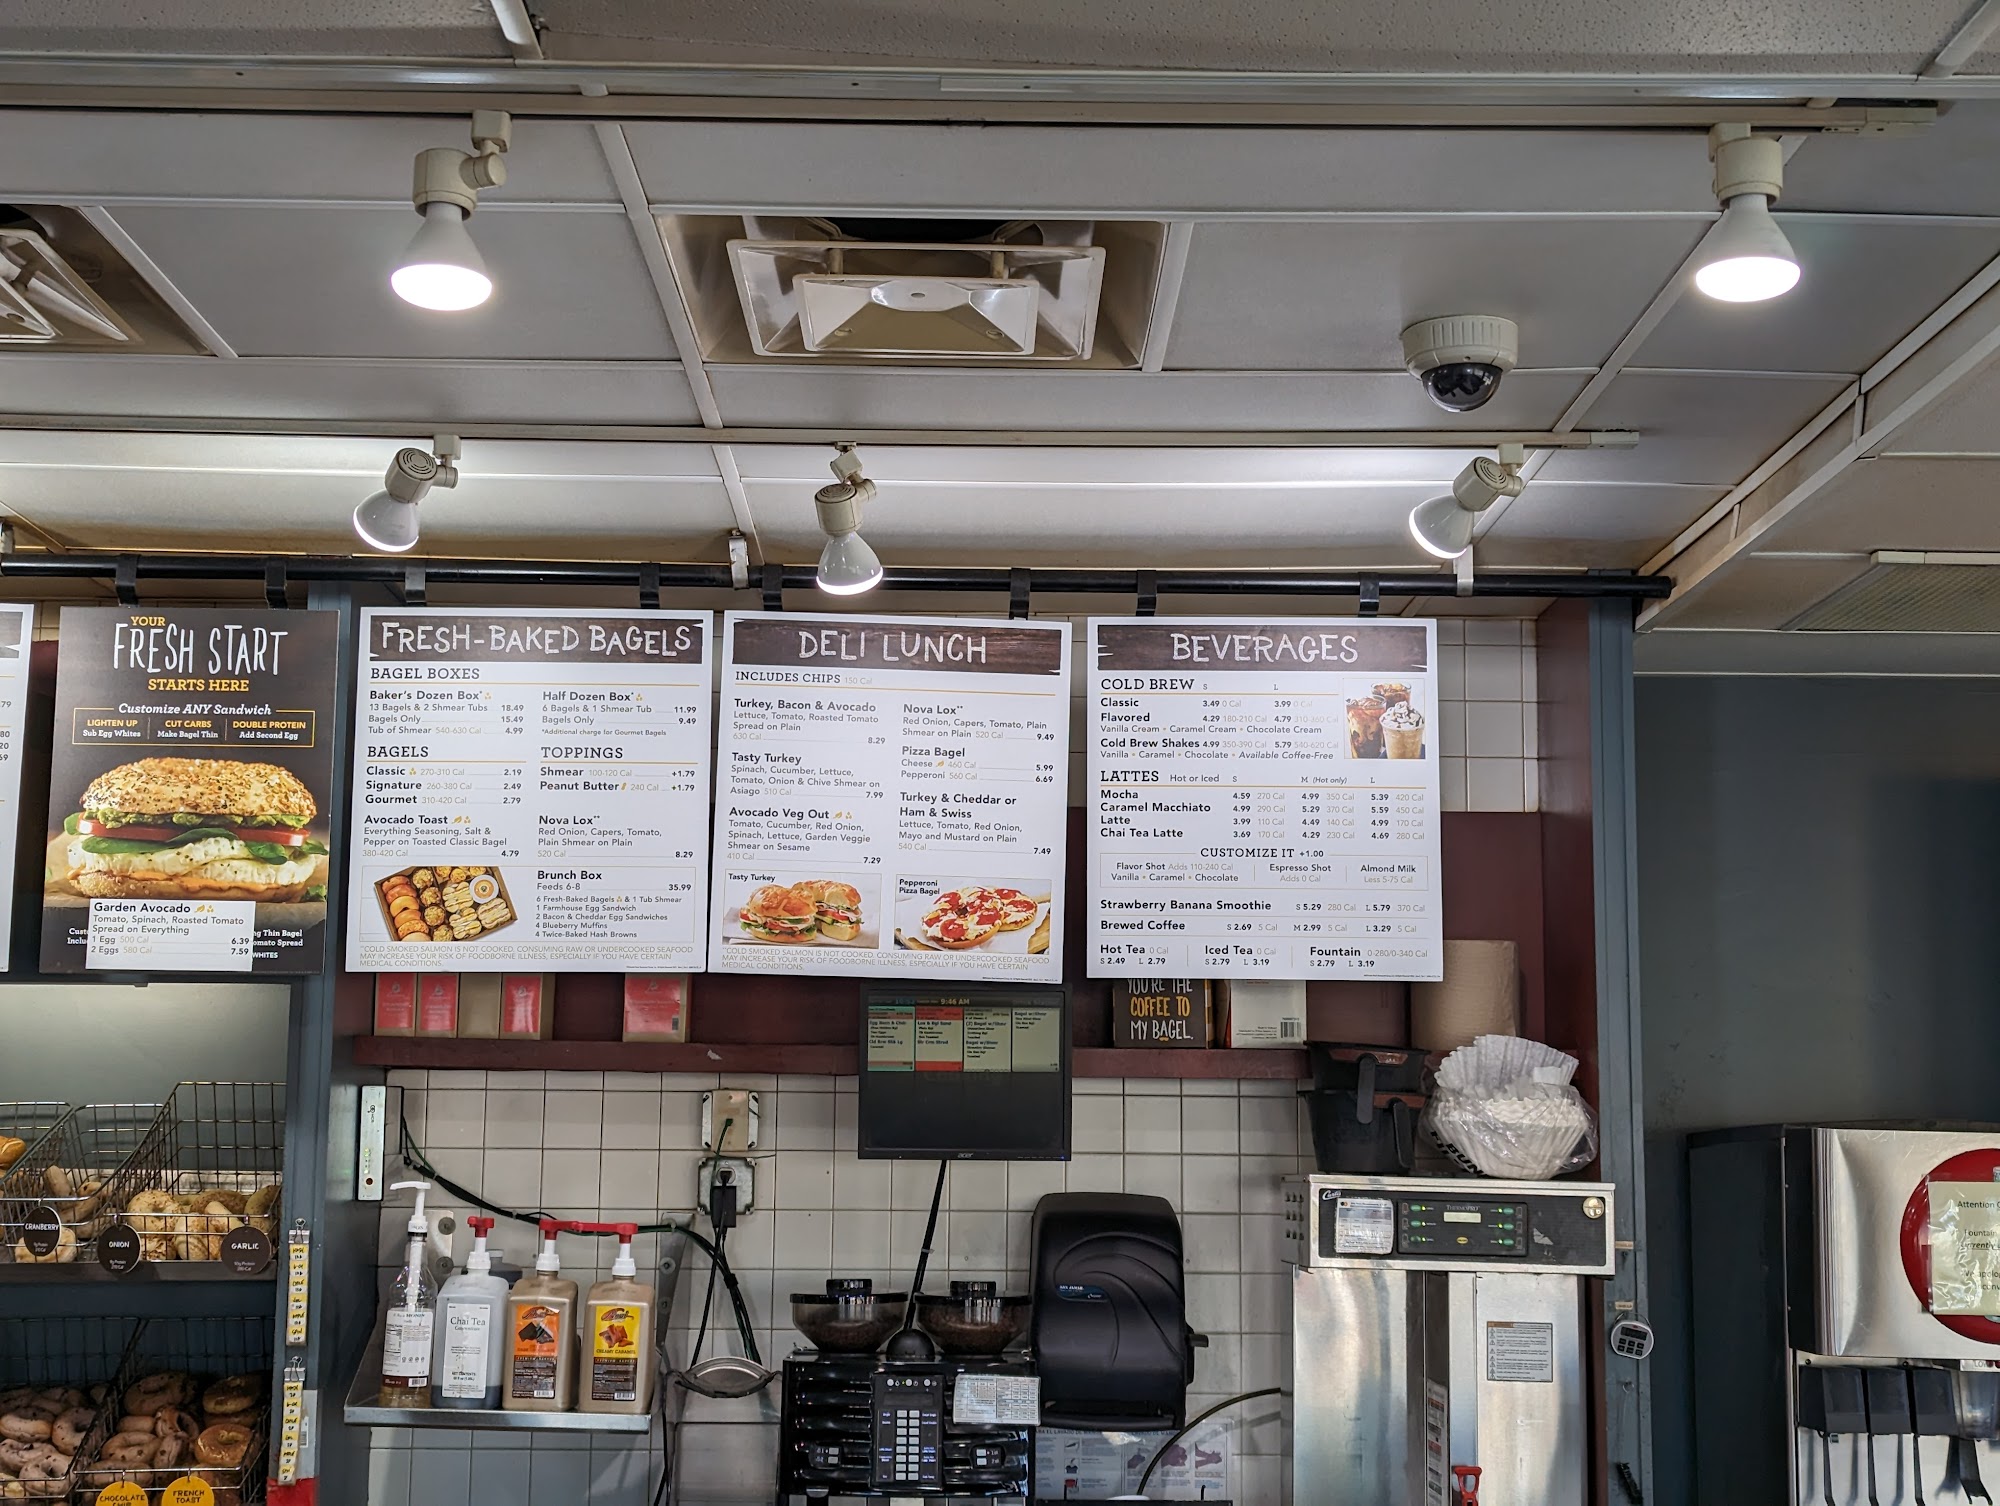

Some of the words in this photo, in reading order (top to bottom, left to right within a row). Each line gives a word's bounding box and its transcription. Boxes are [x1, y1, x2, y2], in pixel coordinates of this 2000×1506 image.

[131, 616, 165, 627] YOUR
[382, 622, 579, 654] FRESH-BAKED
[589, 625, 691, 656] BAGELS
[113, 623, 193, 674] FRESH
[208, 624, 288, 675] START
[799, 630, 865, 661] DELI
[883, 631, 986, 663] LUNCH
[1170, 633, 1358, 663] BEVERAGES
[371, 668, 422, 679] BAGEL
[427, 668, 480, 679] BOXES
[736, 671, 799, 682] INCLUDES
[803, 674, 841, 683] CHIPS
[148, 679, 205, 691] STARTS
[208, 679, 249, 692] HERE
[1101, 678, 1144, 690] COLD
[1150, 679, 1194, 690] BREW
[417, 691, 453, 700] Dozen
[543, 691, 566, 701] Half
[570, 692, 605, 701] Dozen
[734, 699, 774, 710] Turkey,
[778, 700, 811, 709] Bacon
[815, 701, 823, 710] &
[827, 702, 876, 712] Avocado
[1100, 698, 1139, 707] Classic
[118, 703, 181, 715] Customize
[183, 704, 211, 714] ANY
[214, 704, 272, 716] Sandwich
[1101, 713, 1150, 722] Flavored
[87, 718, 122, 728] LIGHTEN
[124, 719, 138, 728] UP
[165, 719, 180, 728] CUT
[182, 719, 212, 728] CARBS
[233, 720, 267, 729] DOUBLE
[269, 720, 306, 729] PROTEIN
[82, 729, 97, 737] Sub
[98, 730, 112, 739] Egg
[114, 729, 141, 738] Whites
[157, 730, 177, 738] Make
[179, 730, 199, 740] Bagel
[201, 730, 218, 738] Thin
[239, 731, 254, 739] Add
[256, 731, 282, 740] Second
[284, 732, 298, 741] Egg
[1100, 738, 1125, 748] Cold
[1130, 739, 1158, 748] Brew
[1162, 739, 1200, 748] Shakes
[367, 746, 429, 758] BAGELS
[541, 747, 623, 759] TOPPINGS
[902, 746, 930, 756] Pizza
[935, 747, 965, 759] Bagel
[732, 752, 761, 764] Tasty
[765, 753, 801, 765] Turkey
[901, 759, 932, 767] Cheese
[367, 766, 405, 775] Classic
[540, 767, 584, 776] Shmear
[901, 771, 945, 780] Pepperoni
[1100, 771, 1159, 782] LATTES
[366, 780, 422, 791] Signature
[366, 795, 417, 804] Gourmet
[900, 792, 937, 803] Turkey
[941, 794, 949, 803] &
[953, 794, 1001, 804] Cheddar
[1005, 797, 1016, 805] or
[1101, 790, 1138, 799] Mocha
[1101, 802, 1148, 812] Caramel
[1152, 803, 1211, 812] Macchiato
[729, 807, 778, 817] Avocado
[783, 809, 804, 820] Veg
[808, 809, 829, 819] Out
[900, 807, 925, 817] Ham
[929, 808, 937, 817] &
[941, 809, 972, 818] Swiss
[364, 815, 414, 824] Avocado
[418, 815, 448, 824] Toast
[539, 816, 569, 825] Nova
[1101, 816, 1130, 825] Latte
[1101, 828, 1125, 838] Chai
[1130, 829, 1149, 838] Tea
[1153, 829, 1183, 838] Latte
[1200, 848, 1277, 858] CUSTOMIZE
[1282, 849, 1294, 857] IT
[1270, 864, 1308, 872] Espresso
[1311, 864, 1331, 872] Shot
[537, 870, 576, 880] Brunch
[581, 871, 602, 880] Box
[751, 874, 775, 882] Turkey
[900, 879, 938, 888] Pepperoni
[920, 888, 940, 896] Bagel
[94, 902, 136, 913] Garden
[140, 902, 191, 913] Avocado
[1101, 900, 1166, 911] Strawberry
[1171, 901, 1212, 910] Banana
[1217, 901, 1271, 910] Smoothie
[93, 915, 128, 925] Tomato,
[132, 915, 169, 926] Spinach,
[172, 916, 208, 925] Roasted
[211, 917, 244, 925] Tomato
[1101, 920, 1143, 930] Brewed
[1148, 921, 1185, 930] Coffee
[1101, 945, 1122, 954] Hot
[1126, 945, 1145, 954] Tea
[1310, 947, 1360, 957] Fountain
[1131, 997, 1170, 1017] COFFEE
[1176, 996, 1190, 1016] TO
[1131, 1020, 1147, 1040] MY
[1153, 1019, 1194, 1040] BAGEL.
[450, 1317, 469, 1325] Chai
